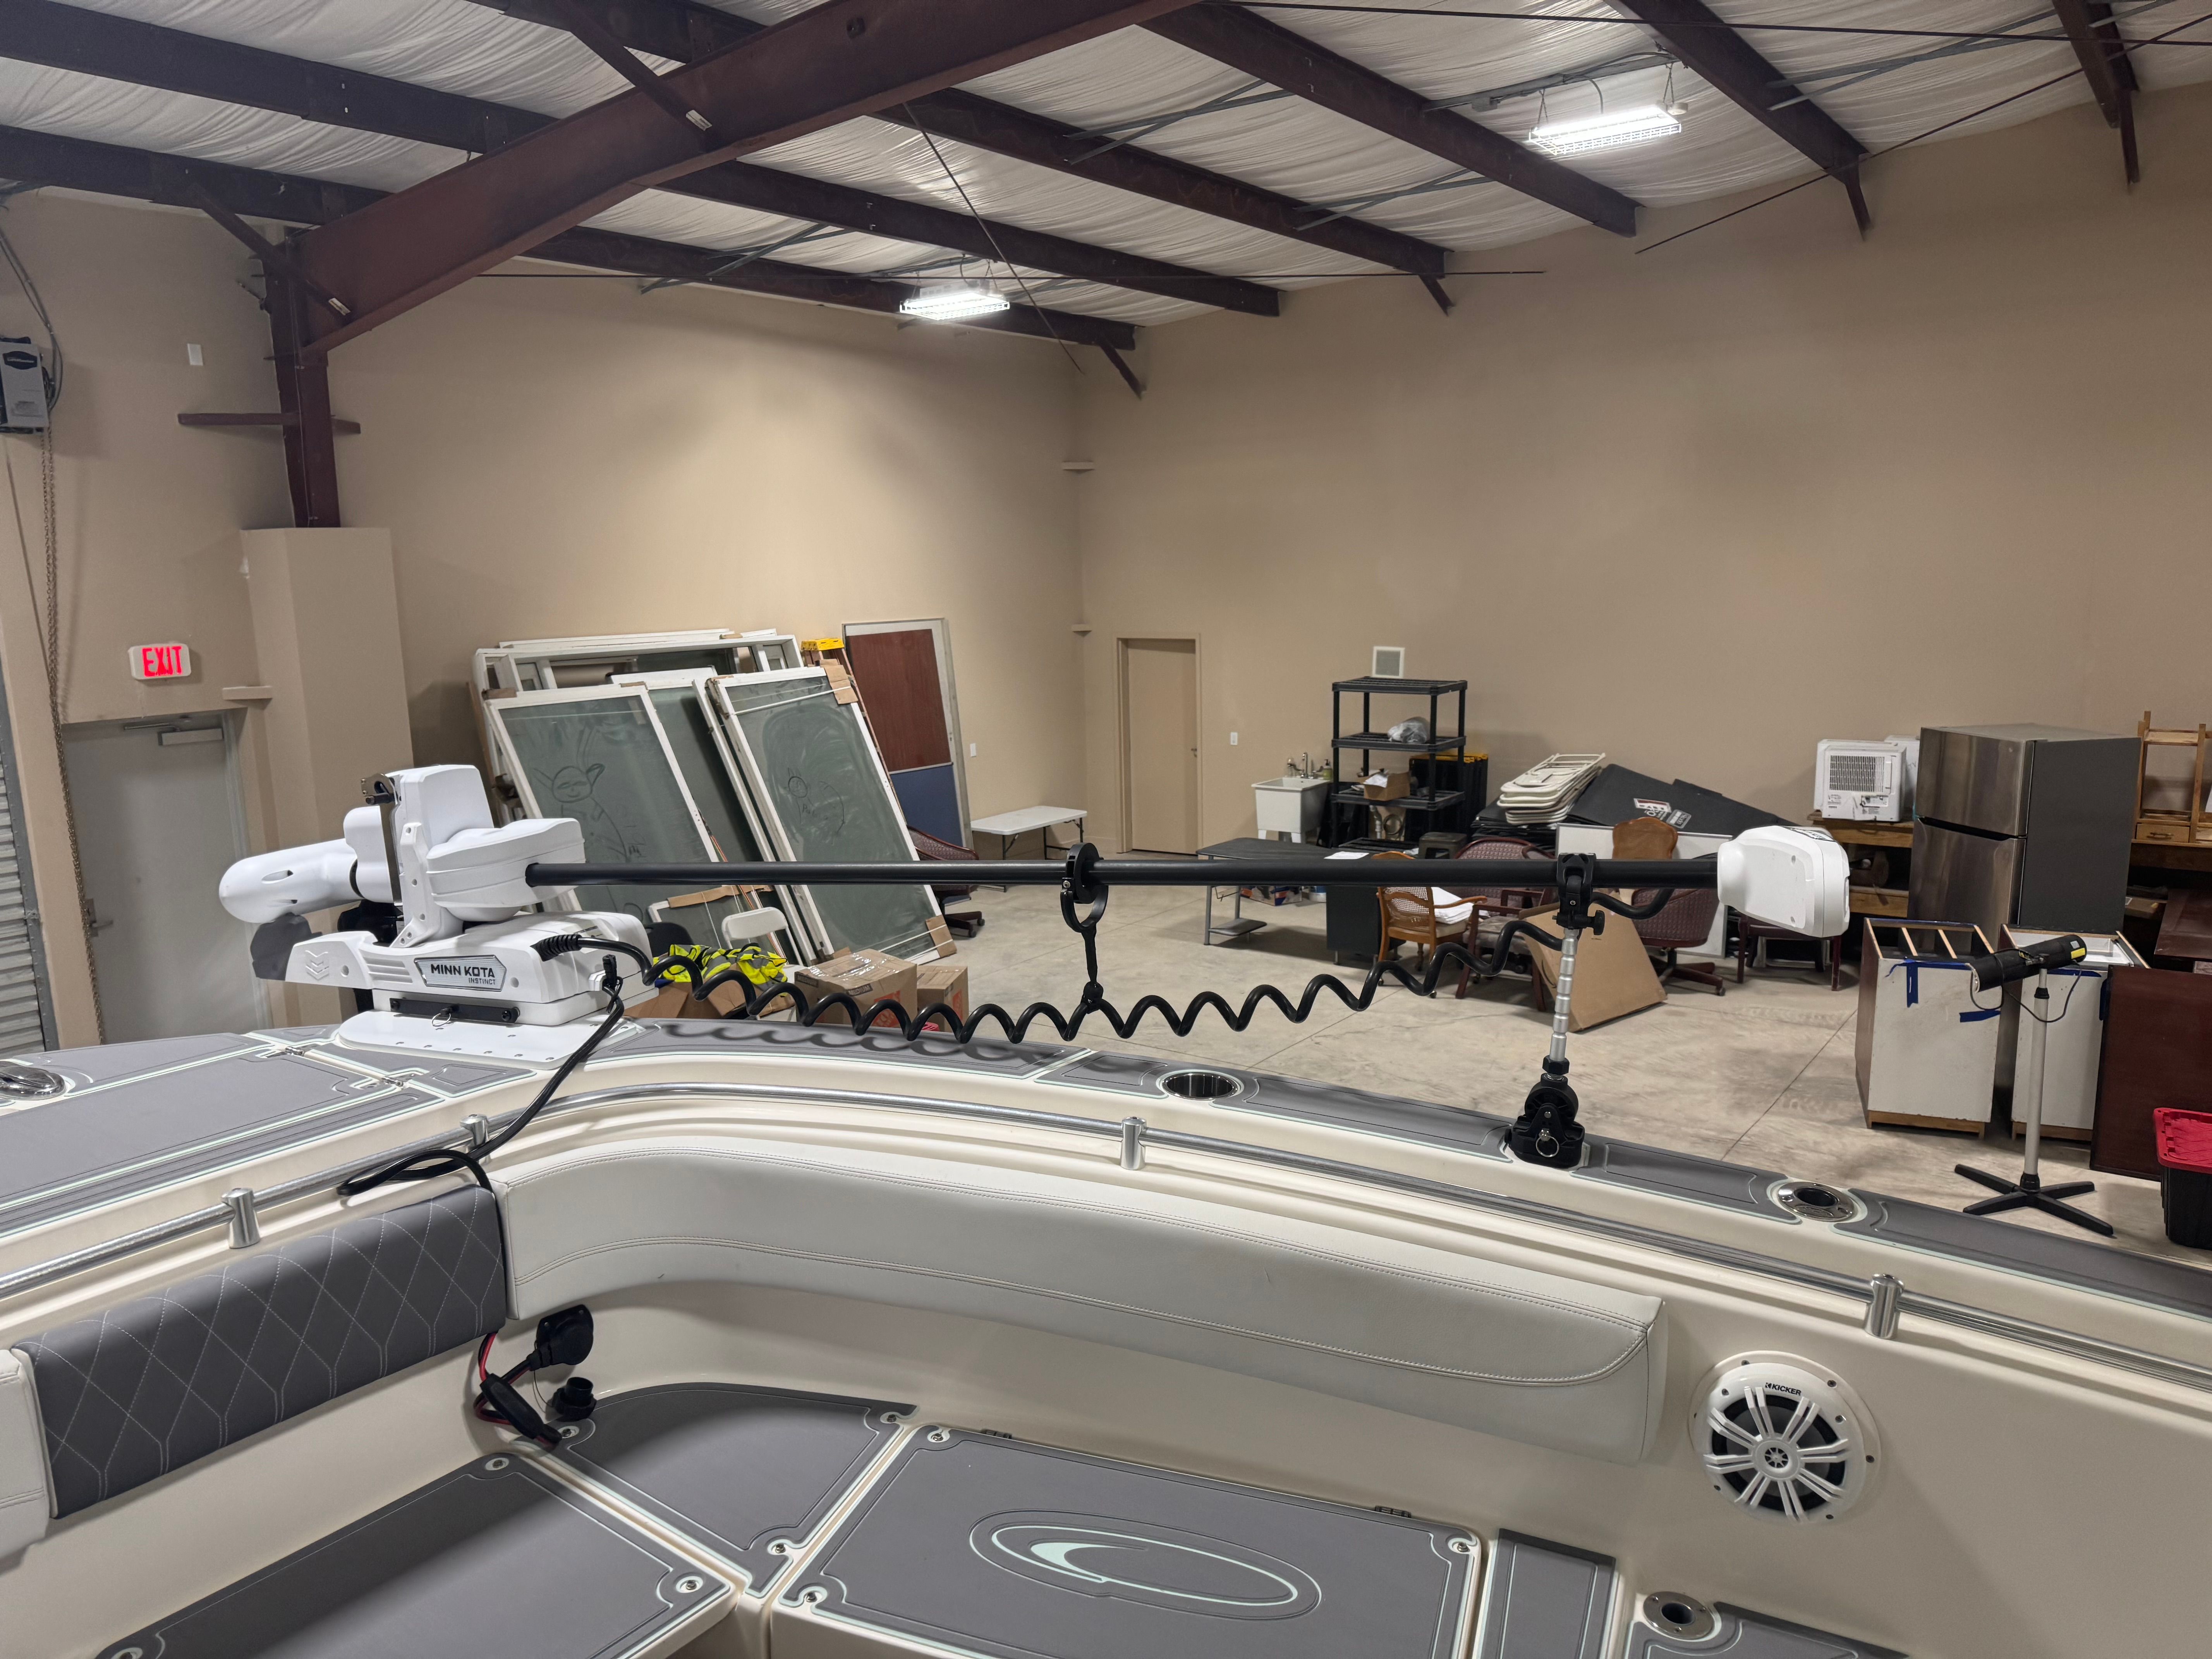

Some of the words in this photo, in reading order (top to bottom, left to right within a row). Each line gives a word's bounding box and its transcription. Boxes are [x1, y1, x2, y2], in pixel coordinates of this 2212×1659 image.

[142, 646, 182, 677] EXIT
[431, 964, 461, 975] MINN
[464, 966, 495, 978] KOTA
[1772, 1383, 1802, 1396] KICKER
